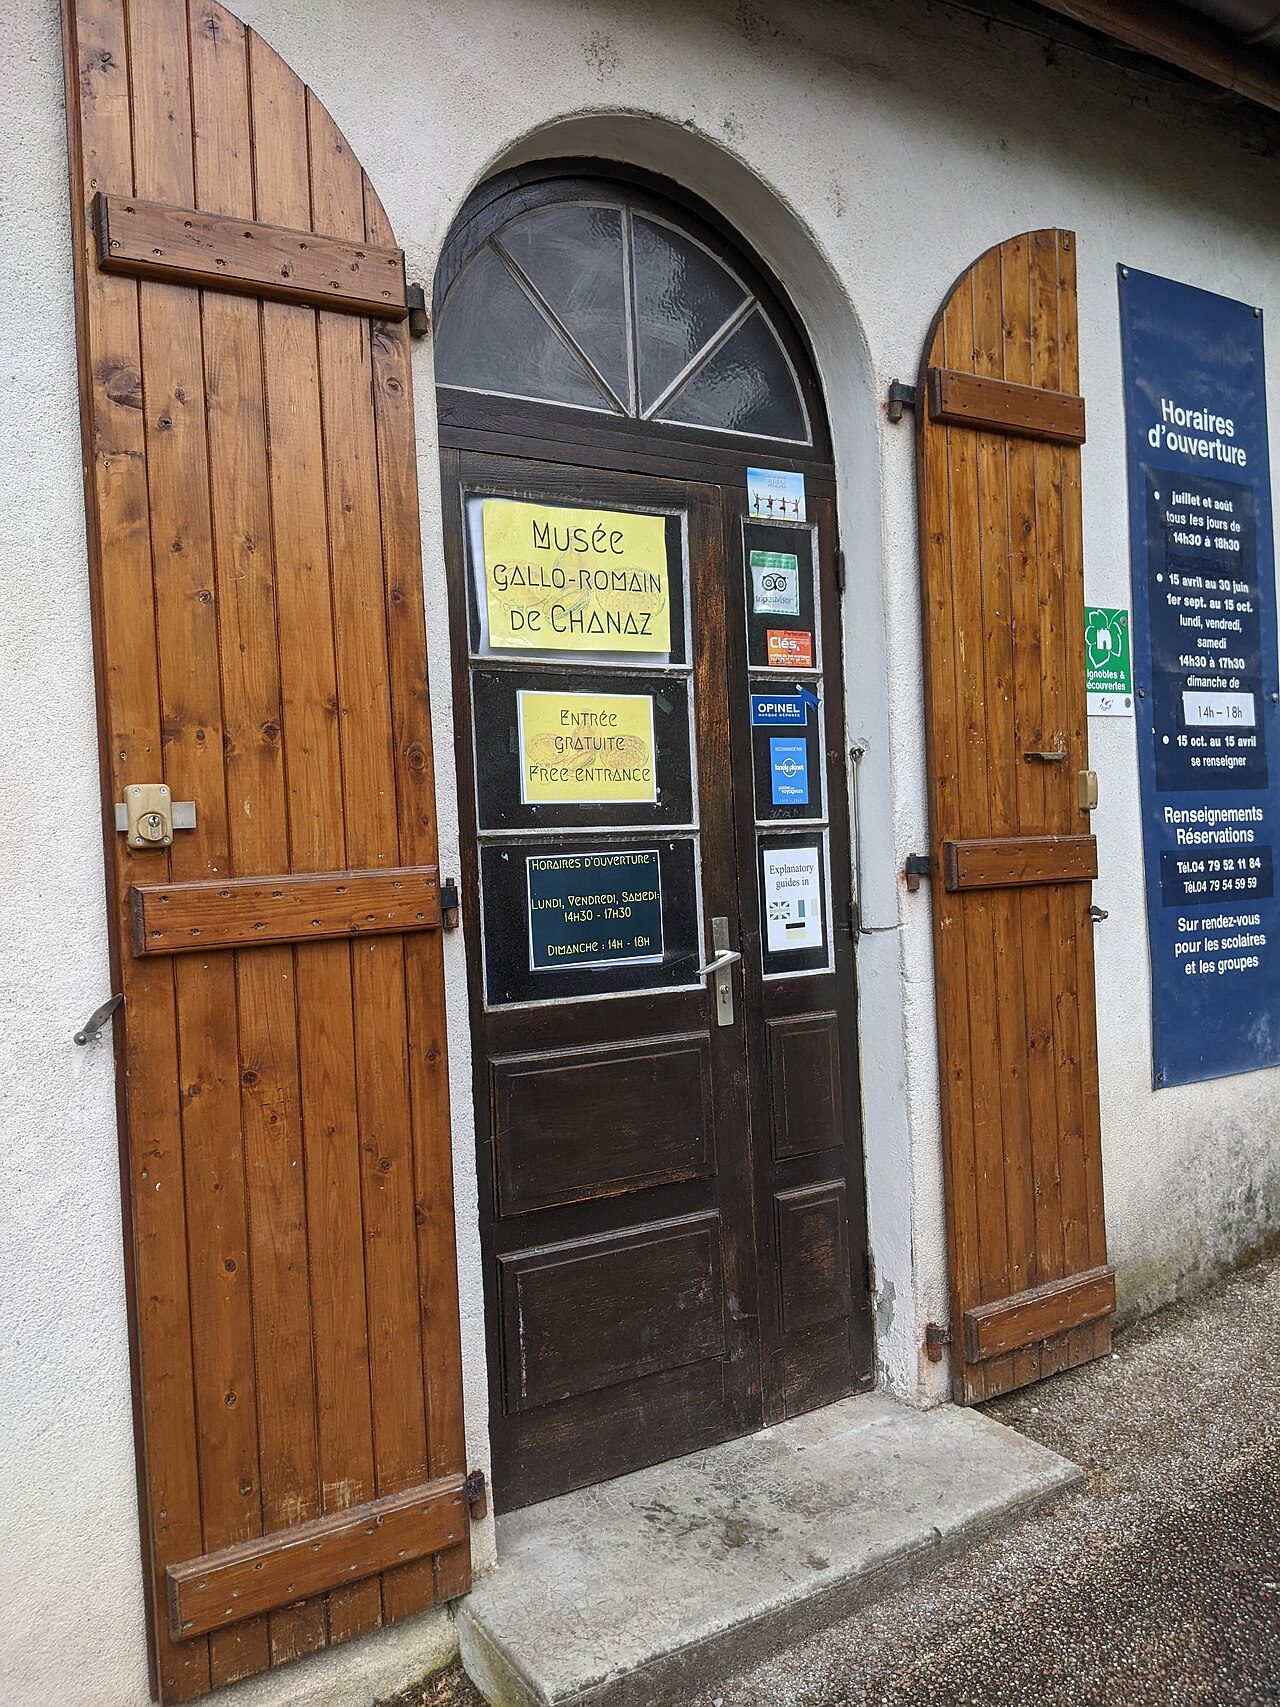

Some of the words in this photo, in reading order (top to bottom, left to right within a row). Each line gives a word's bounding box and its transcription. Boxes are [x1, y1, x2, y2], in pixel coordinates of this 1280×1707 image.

[1161, 398, 1235, 437] Horaires
[1148, 424, 1247, 467] d’ouverture
[1171, 491, 1200, 507] juillet
[1202, 497, 1212, 508] et
[1165, 510, 1186, 525] tous
[1189, 513, 1204, 527] les
[1206, 516, 1228, 531] jours
[1229, 521, 1241, 533] de
[1173, 531, 1201, 546] 14h30
[1204, 535, 1211, 548] à
[1214, 536, 1240, 551] 18h30
[493, 564, 661, 593] GALLO-ROMAIN
[1168, 573, 1180, 586] 15
[1182, 575, 1202, 588] avril
[1205, 579, 1217, 590] au
[1218, 579, 1230, 591] 30
[1232, 580, 1249, 594] juin
[755, 594, 792, 605] tripadvisor
[1167, 593, 1182, 606] 1er
[1183, 595, 1207, 609] sept.
[1209, 598, 1221, 610] au
[1224, 599, 1234, 611] 15
[1236, 601, 1253, 613] oct.
[1179, 613, 1203, 630] lundi,
[1205, 617, 1242, 633] vendredi,
[1197, 637, 1227, 650] samedi
[1179, 655, 1207, 668] 14h30
[1209, 656, 1215, 669] à
[1218, 656, 1245, 670] 17h30
[1086, 668, 1118, 680] ignobles
[1119, 670, 1126, 680] &
[1086, 680, 1126, 691] écouvertes
[1187, 675, 1227, 688] dimanche
[1229, 676, 1240, 689] de
[758, 703, 800, 713] OPINEL
[1197, 705, 1215, 718] 14h
[1226, 706, 1243, 719] 18h
[1177, 735, 1188, 747] 15
[1190, 735, 1207, 747] oct.
[1209, 738, 1221, 747] au
[1224, 735, 1235, 747] 15
[1237, 735, 1257, 747] avril
[774, 763, 789, 773] lonely
[789, 763, 804, 772] planet
[1191, 757, 1201, 767] se
[1202, 755, 1247, 770] renseigner
[1164, 805, 1263, 826] Renseignements
[1176, 827, 1254, 845] Réservations
[769, 863, 814, 876] Explanatory
[1208, 859, 1220, 872] 79
[1222, 858, 1234, 871] 52
[1237, 858, 1246, 870] 11
[1249, 857, 1261, 869] 84
[775, 877, 800, 890] guides
[802, 877, 809, 886] in
[1209, 880, 1220, 891] 79
[1222, 879, 1233, 890] 54
[1234, 878, 1246, 890] 59
[1247, 877, 1257, 888] 59
[1177, 917, 1199, 932] Sur
[1201, 913, 1261, 930] rendez-vous
[1174, 940, 1201, 958] pour
[1204, 937, 1219, 952] les
[1221, 932, 1266, 949] scolaires
[1184, 960, 1196, 975] et
[1199, 959, 1216, 974] les
[1217, 955, 1259, 975] groupes
